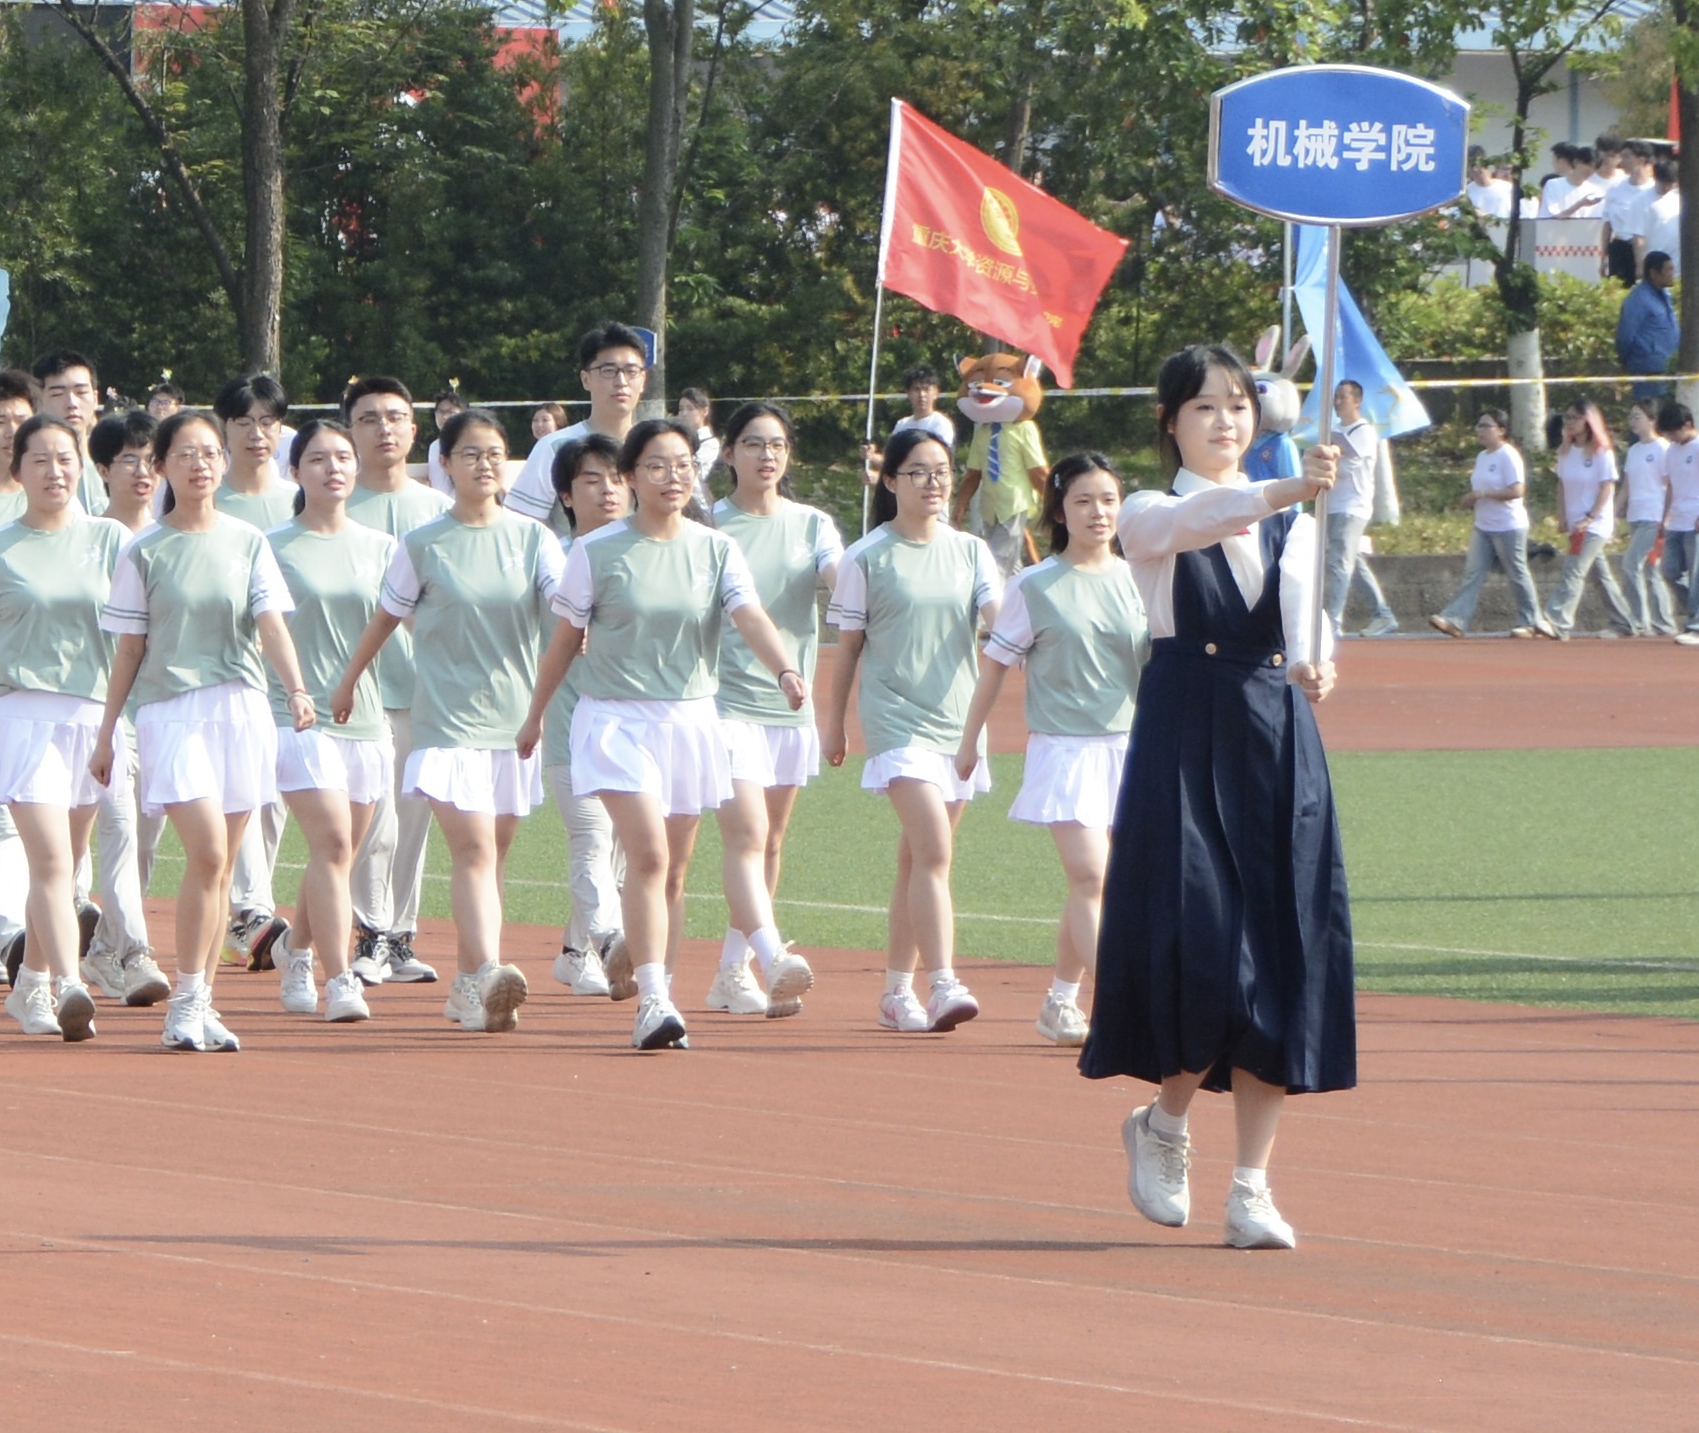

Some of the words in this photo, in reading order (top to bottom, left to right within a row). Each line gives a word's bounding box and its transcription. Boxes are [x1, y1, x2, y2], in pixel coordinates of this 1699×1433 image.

[1247, 118, 1436, 172] 机械学院
[911, 223, 1038, 295] 重庆大学资源与
